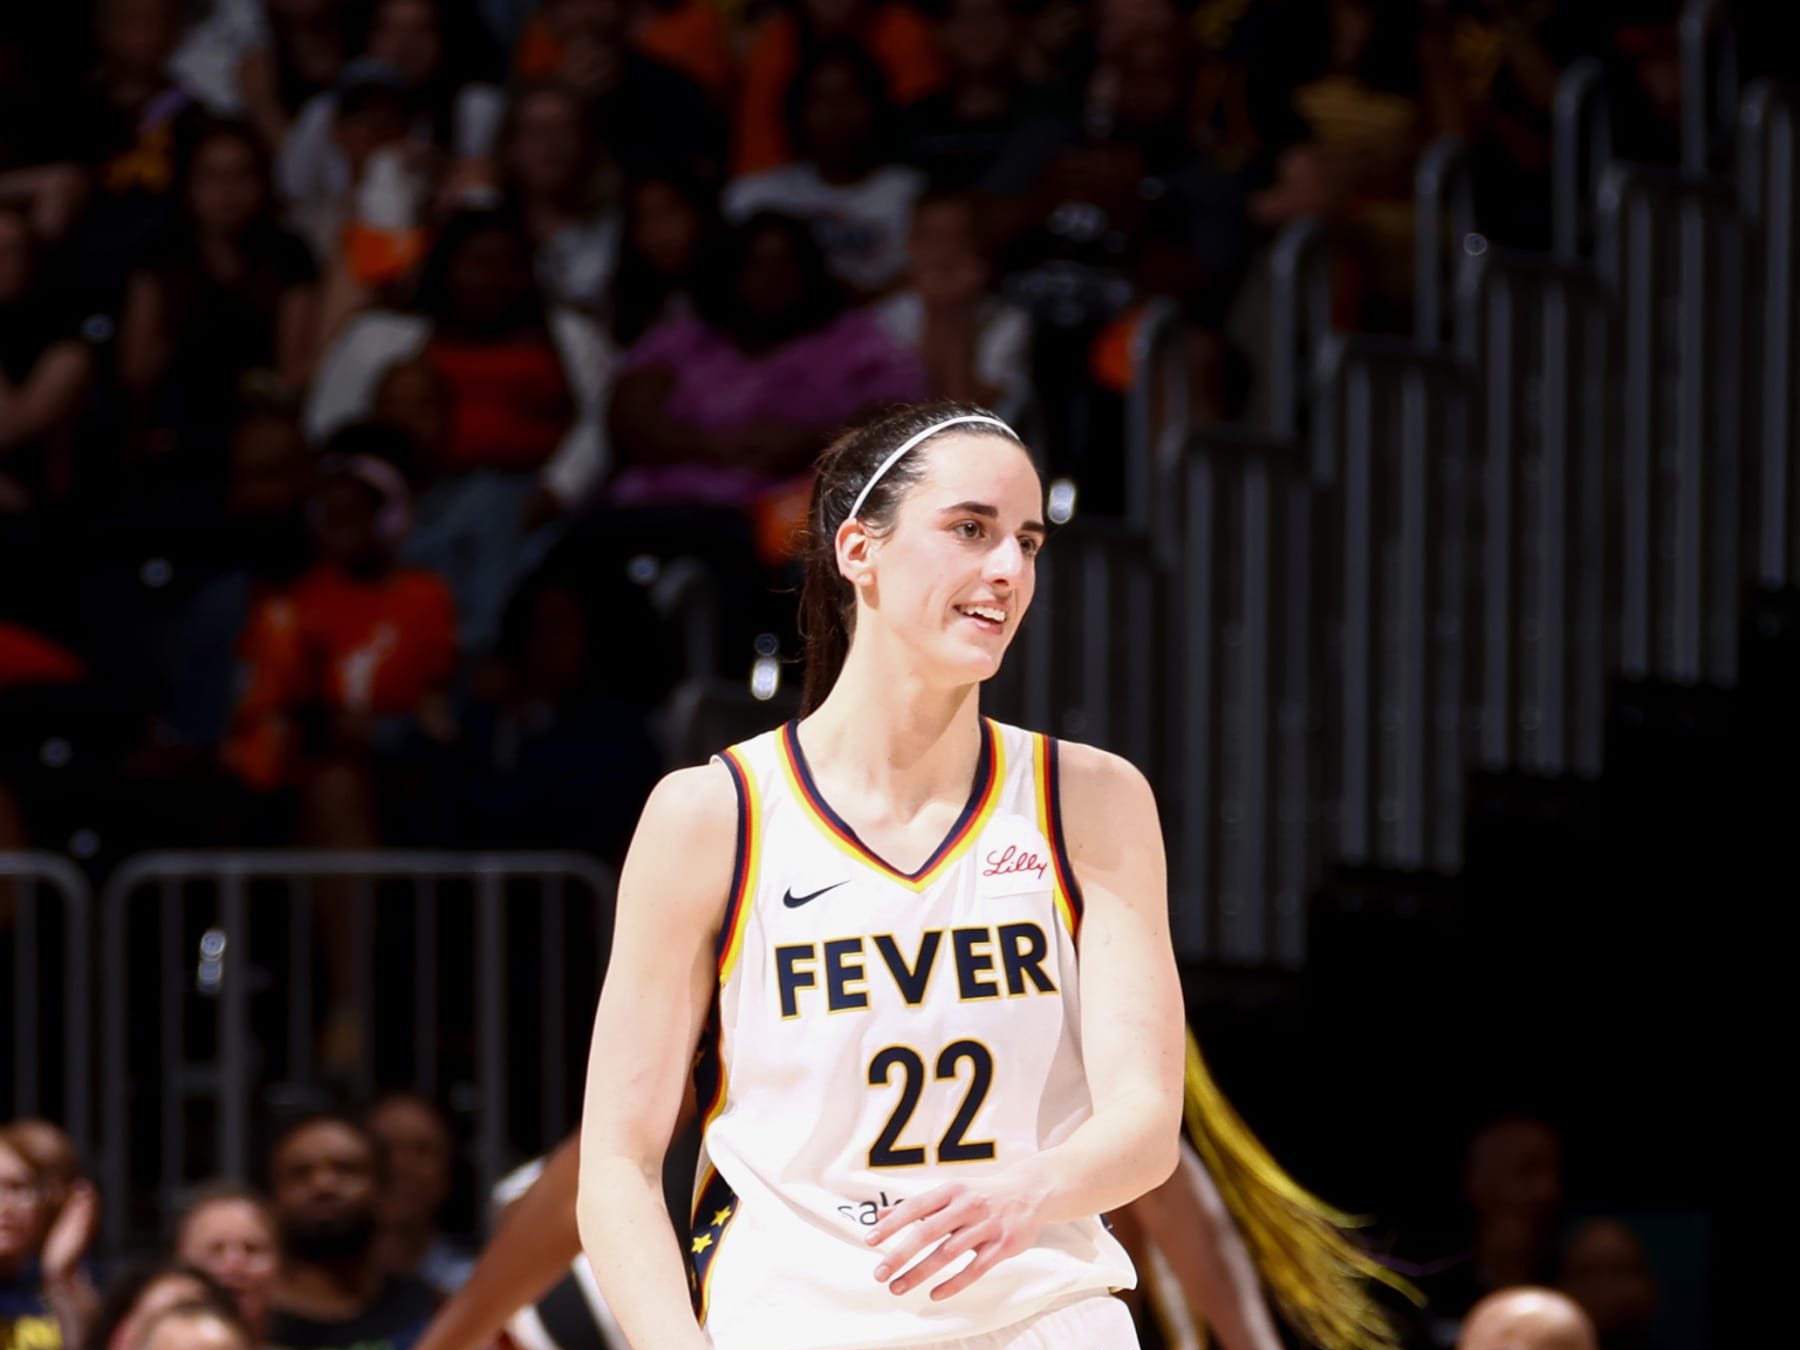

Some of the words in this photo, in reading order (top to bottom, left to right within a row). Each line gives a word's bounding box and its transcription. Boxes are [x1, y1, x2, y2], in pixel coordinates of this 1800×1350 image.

[983, 844, 1047, 880] Lilly
[774, 921, 1060, 1020] FEVER
[866, 1036, 997, 1170] 22
